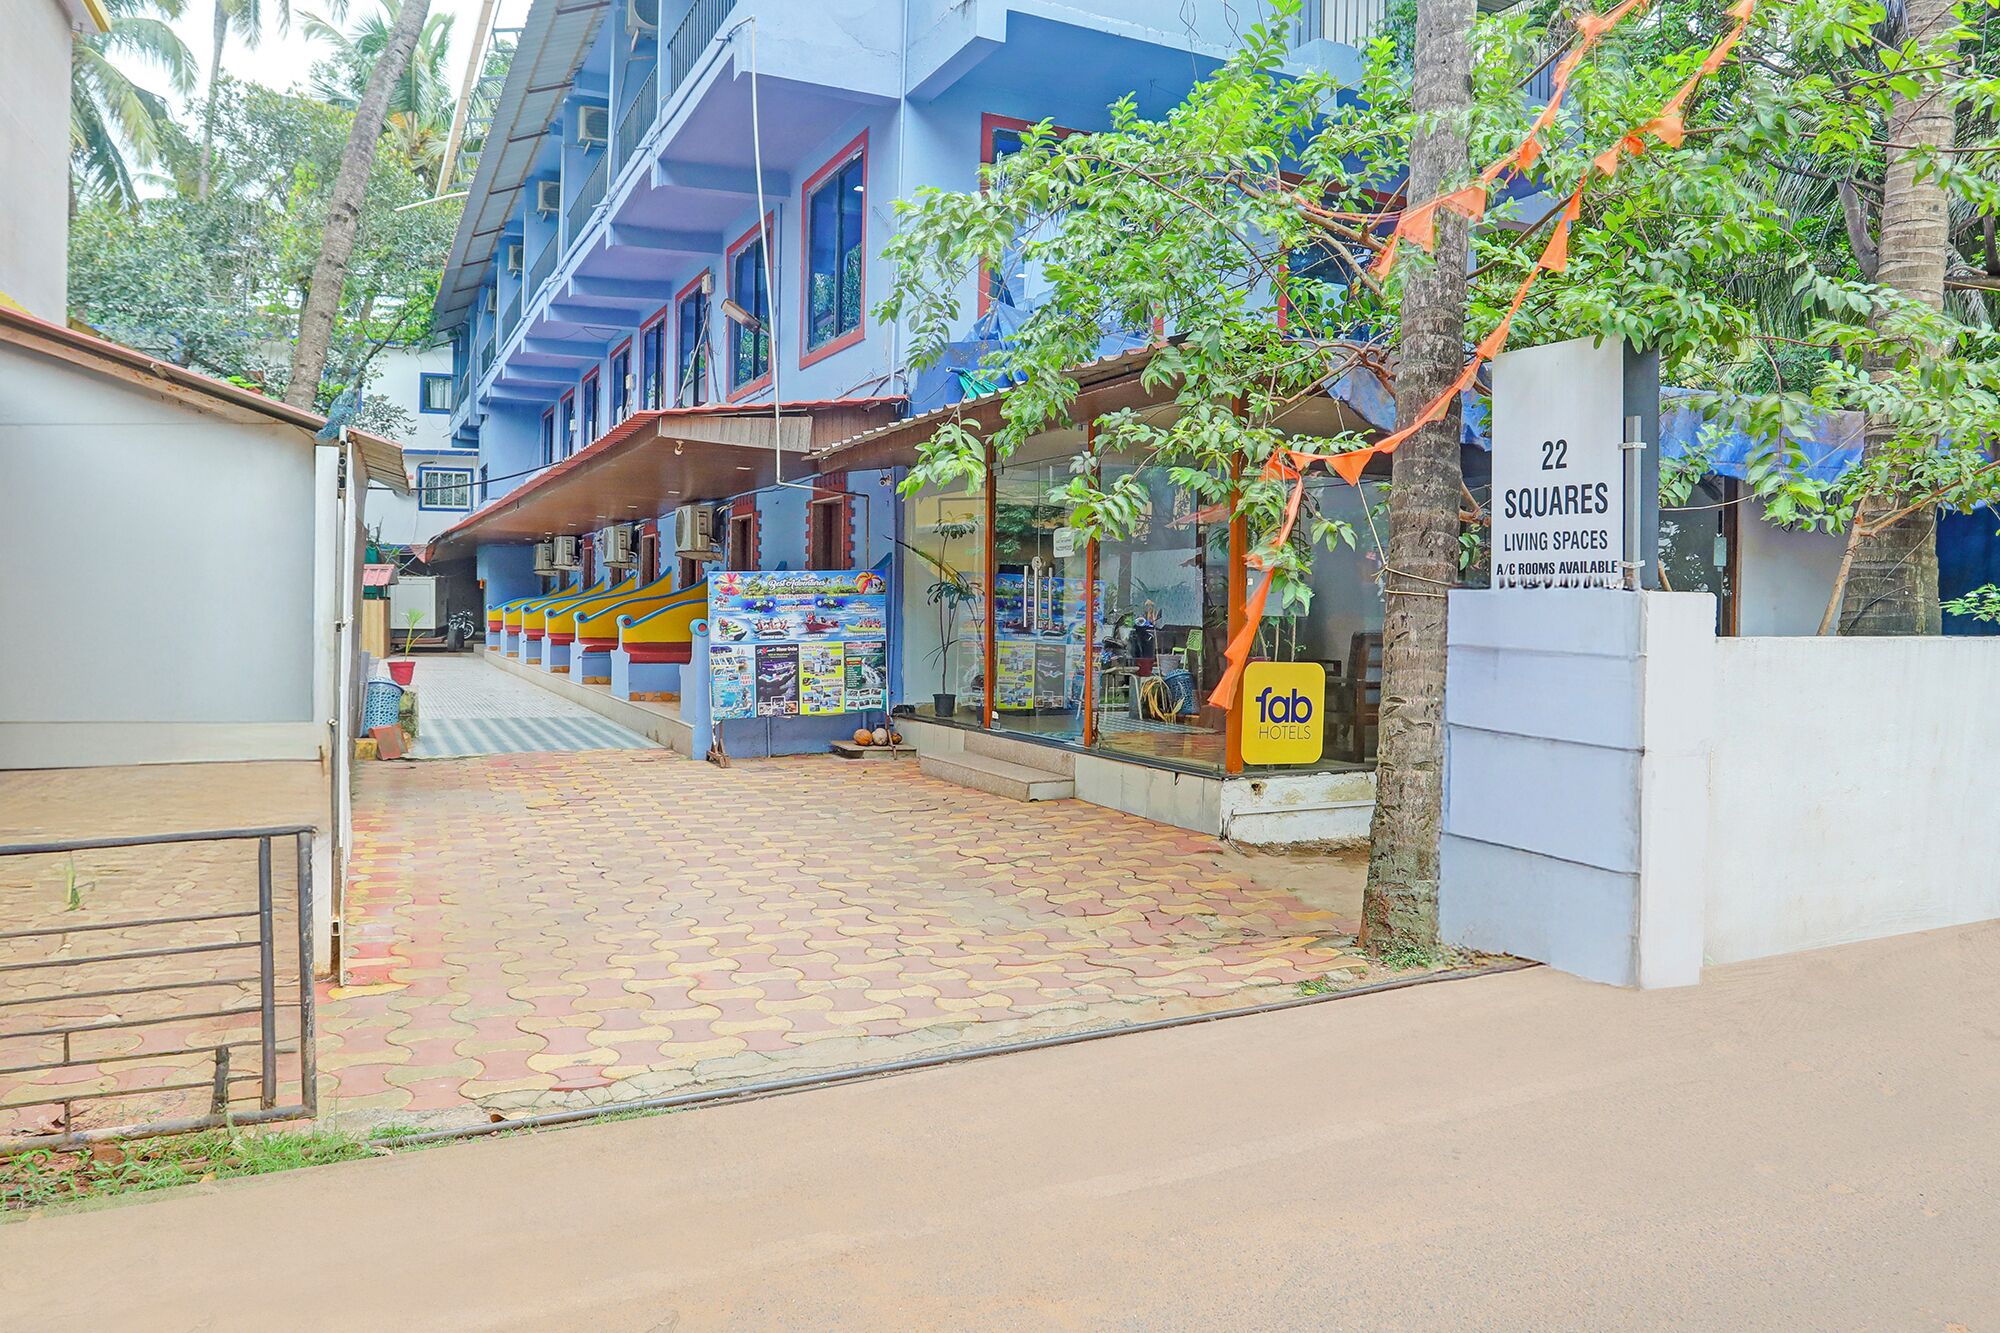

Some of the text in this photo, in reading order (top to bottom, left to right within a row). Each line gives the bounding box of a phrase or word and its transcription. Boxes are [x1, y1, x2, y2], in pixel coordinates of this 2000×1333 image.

[1541, 439, 1568, 471] 22
[1504, 482, 1609, 519] SQUARES
[1504, 530, 1608, 552] LIVING SPACES
[1496, 560, 1618, 576] A/C ROOMS AVAILABLE
[768, 578, 825, 590] Best Adventures
[1255, 686, 1313, 724] fab
[1258, 725, 1312, 740] HOTELS
